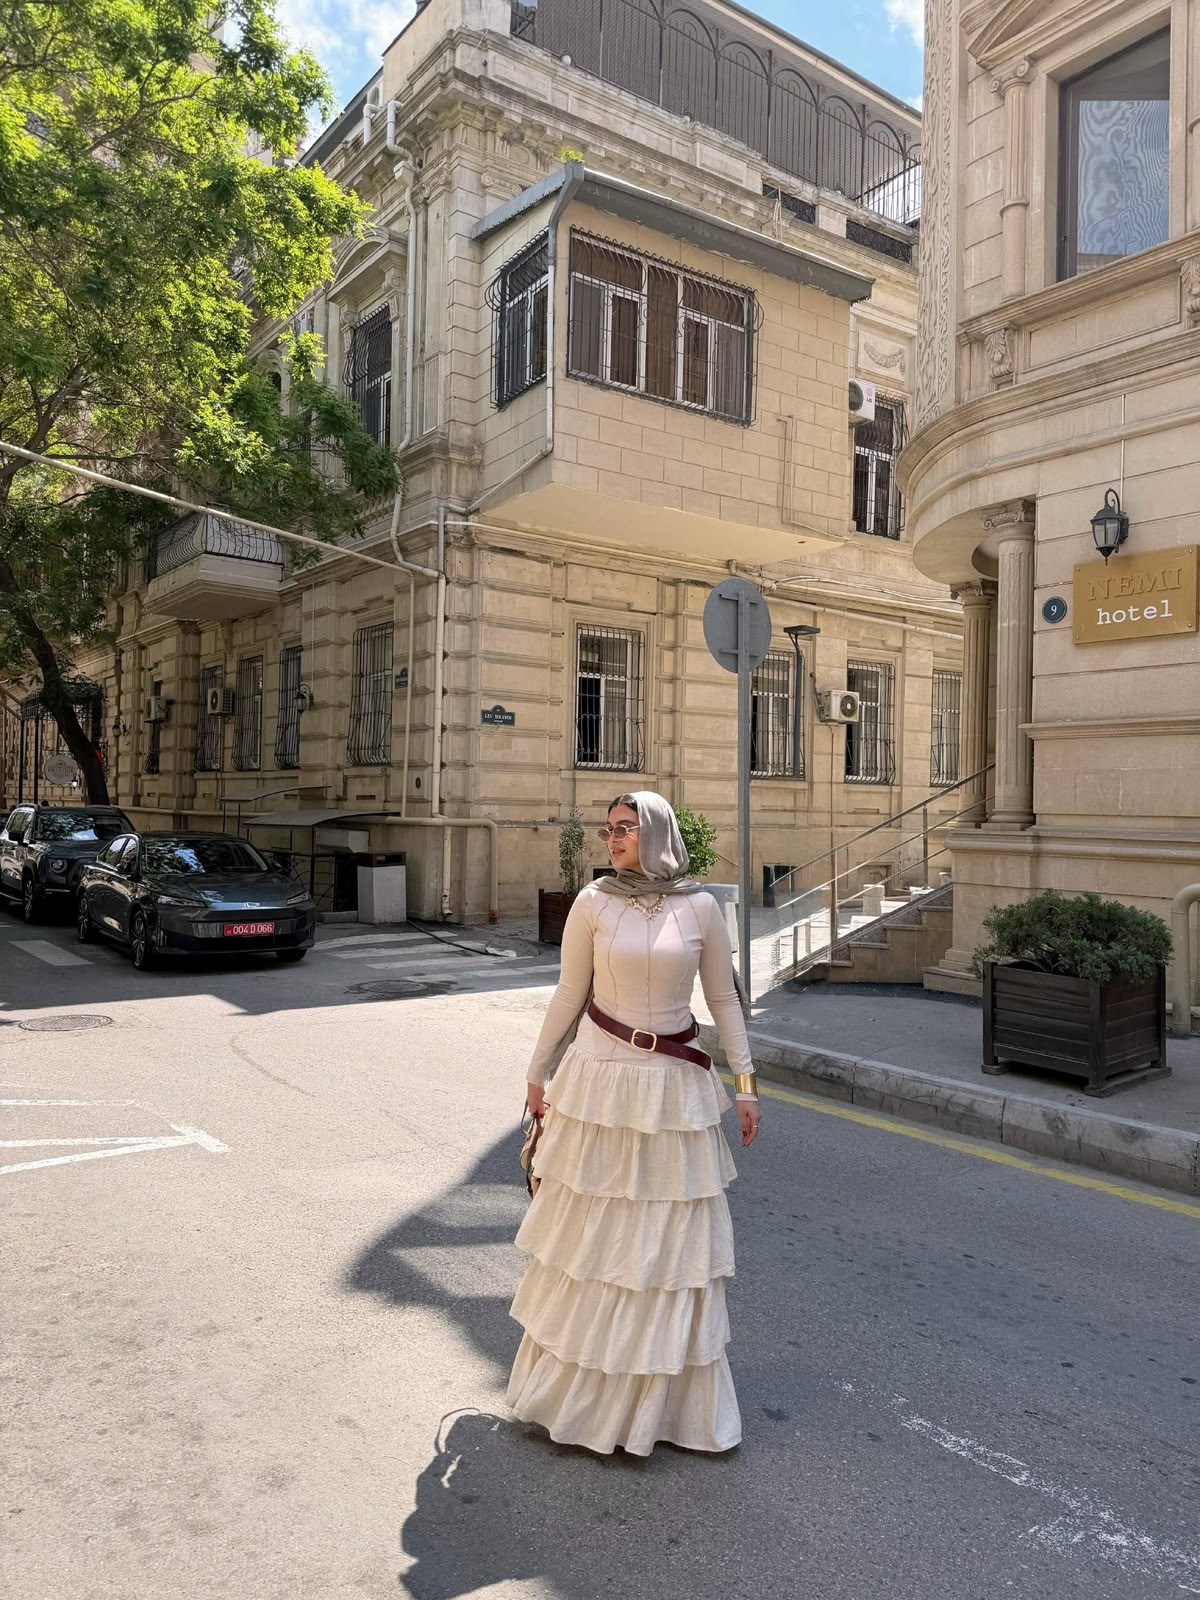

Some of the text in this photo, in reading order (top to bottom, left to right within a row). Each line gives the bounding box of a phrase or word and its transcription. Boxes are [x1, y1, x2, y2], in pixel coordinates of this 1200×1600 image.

[1087, 567, 1182, 601] NEMI
[1050, 604, 1057, 616] 9
[1096, 599, 1173, 625] hotel
[233, 925, 249, 934] 004
